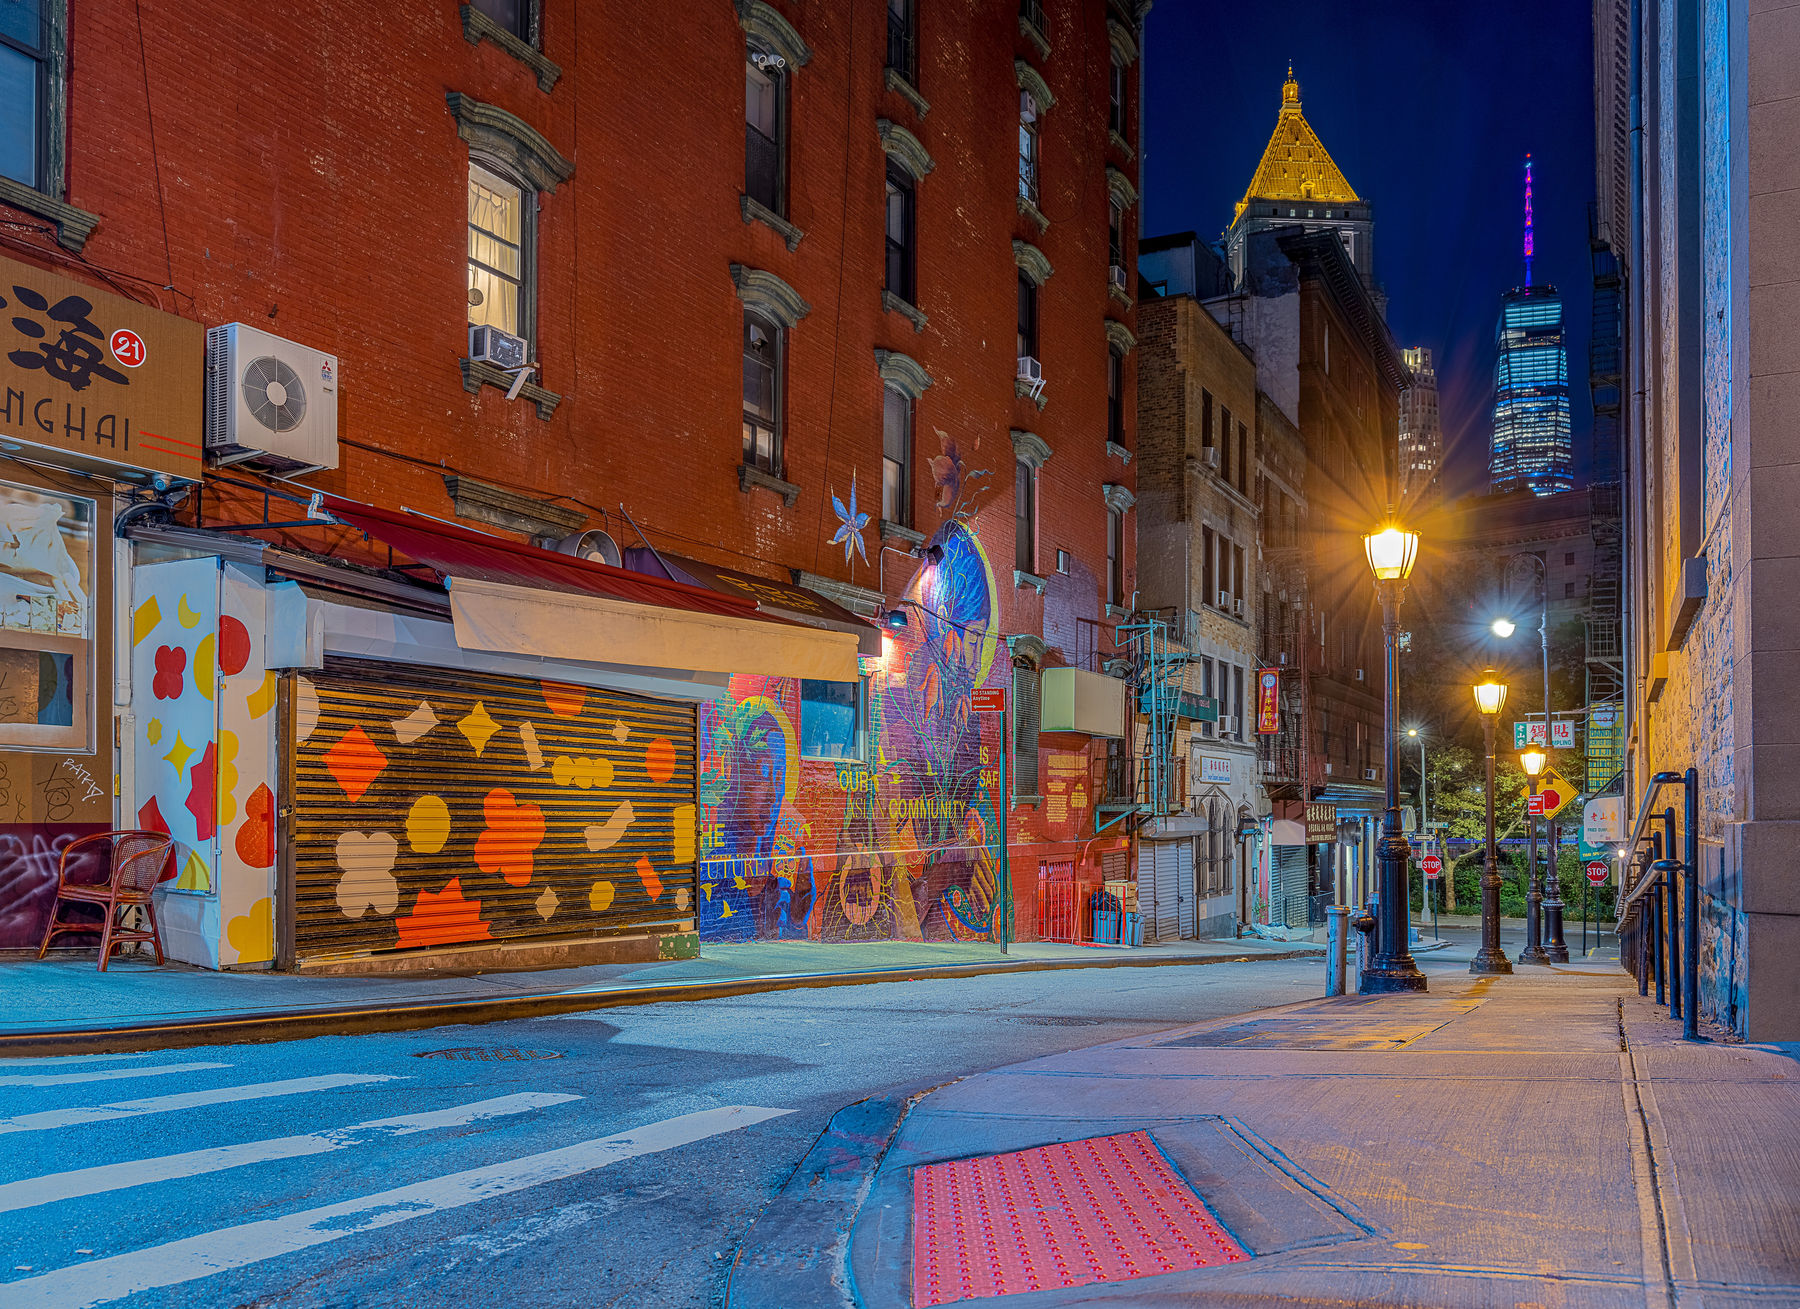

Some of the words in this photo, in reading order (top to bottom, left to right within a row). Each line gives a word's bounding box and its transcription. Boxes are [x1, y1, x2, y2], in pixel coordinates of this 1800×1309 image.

[0, 286, 130, 391] 海
[115, 336, 140, 361] 21
[979, 746, 989, 765] IS
[839, 770, 869, 792] OUR
[979, 769, 1001, 788] SAF
[846, 798, 886, 819] ASIAN
[888, 798, 966, 819] COMMUNITY
[699, 823, 726, 848] HE
[700, 853, 770, 880] UTURE.
[1423, 860, 1441, 869] STOP
[1586, 867, 1608, 876] STOP
